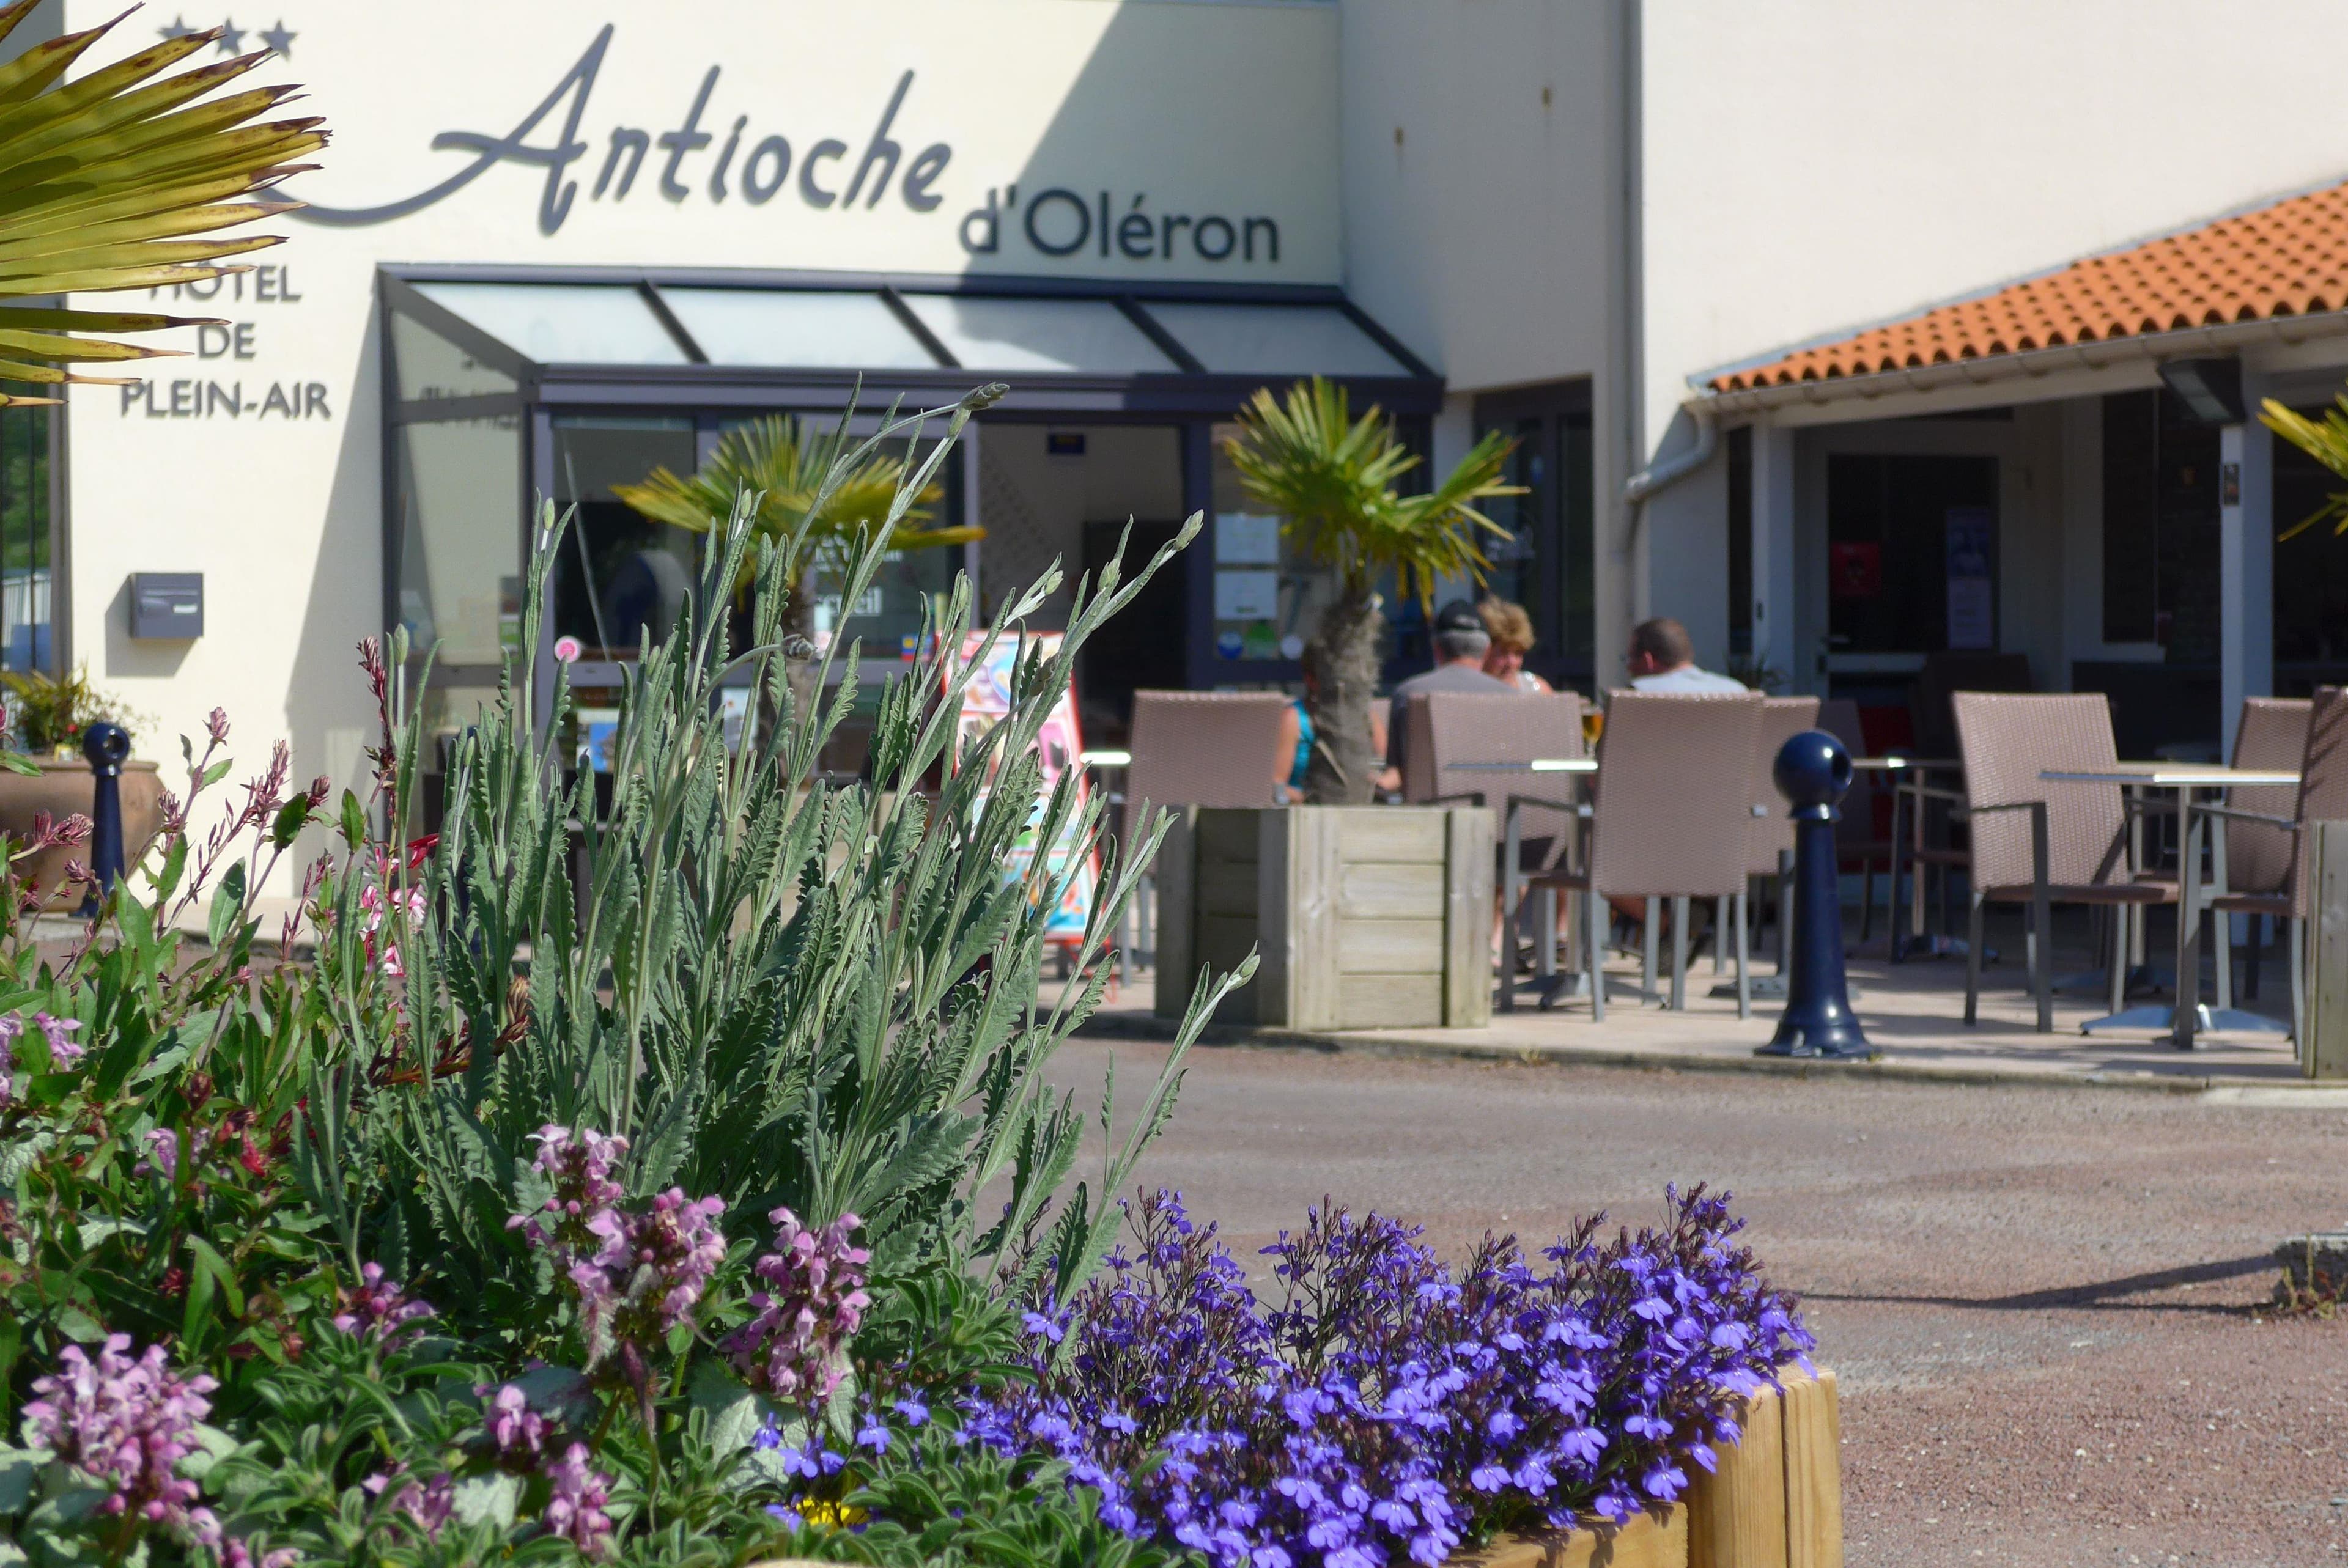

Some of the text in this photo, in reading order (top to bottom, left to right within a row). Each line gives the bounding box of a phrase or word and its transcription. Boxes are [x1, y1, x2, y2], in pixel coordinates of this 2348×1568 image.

[252, 23, 1280, 262] Antioche d'Oléron
[198, 322, 256, 359] DE
[120, 380, 332, 420] PLEIN-AIR
